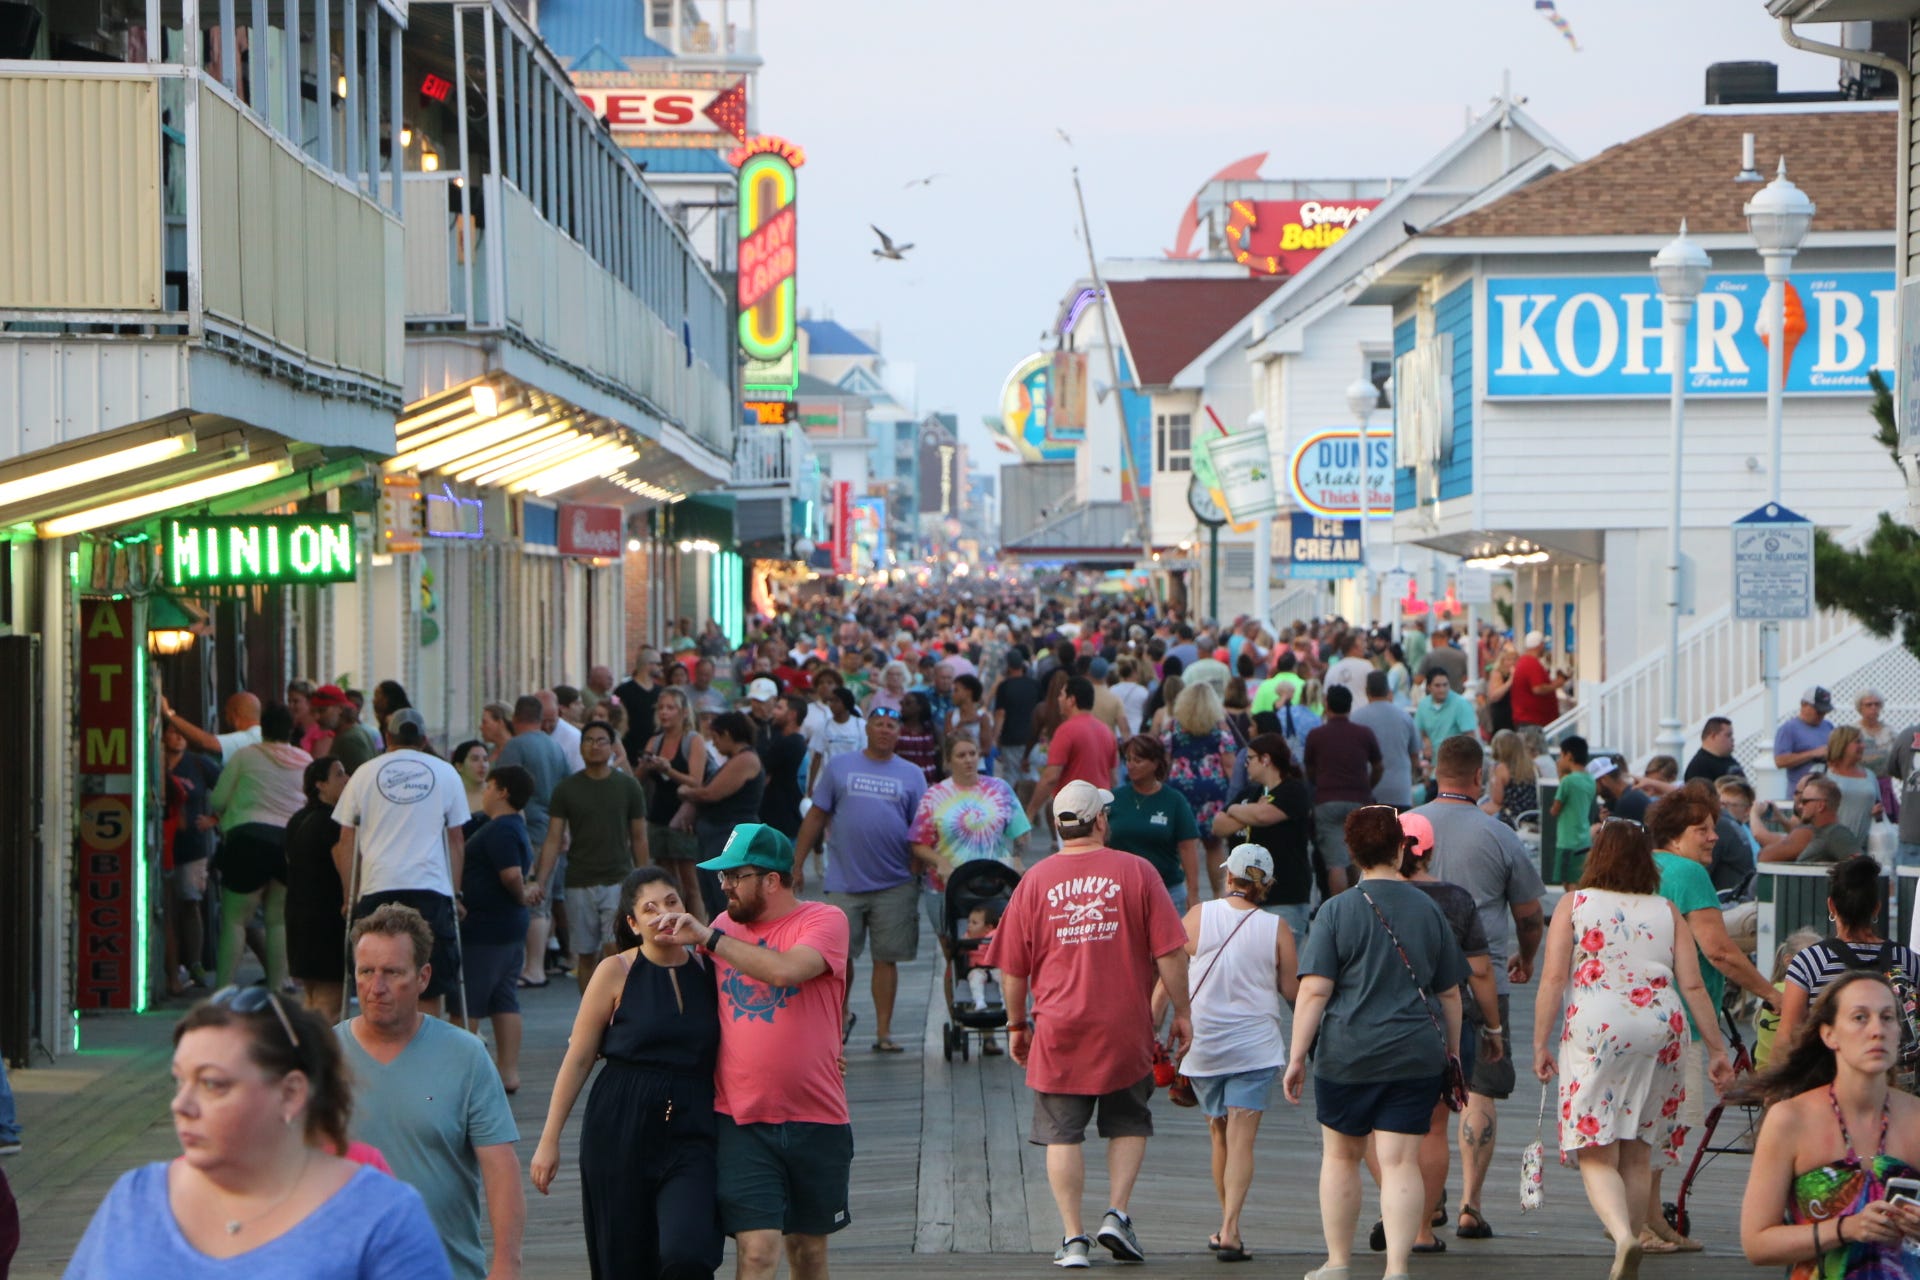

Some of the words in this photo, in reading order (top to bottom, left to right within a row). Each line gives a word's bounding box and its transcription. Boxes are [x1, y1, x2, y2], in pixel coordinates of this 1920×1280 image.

[740, 211, 792, 272] PLAY
[740, 246, 794, 305] LAND
[1716, 281, 1748, 291] Since
[1810, 281, 1837, 290] 1919
[1495, 292, 1749, 377] KOHR
[1692, 374, 1748, 388] Frozen
[1313, 518, 1344, 537] ICE
[173, 520, 351, 585] MINION
[1294, 538, 1361, 560] CREAM
[86, 603, 126, 766] ATM
[854, 783, 879, 792] EAGLE
[855, 778, 895, 788] AMERICAN
[1047, 876, 1120, 907] STINKY'S
[88, 853, 121, 1009] BUCKET
[1056, 925, 1085, 937] HOUSE
[1085, 923, 1096, 933] OF
[1098, 921, 1119, 932] FISH
